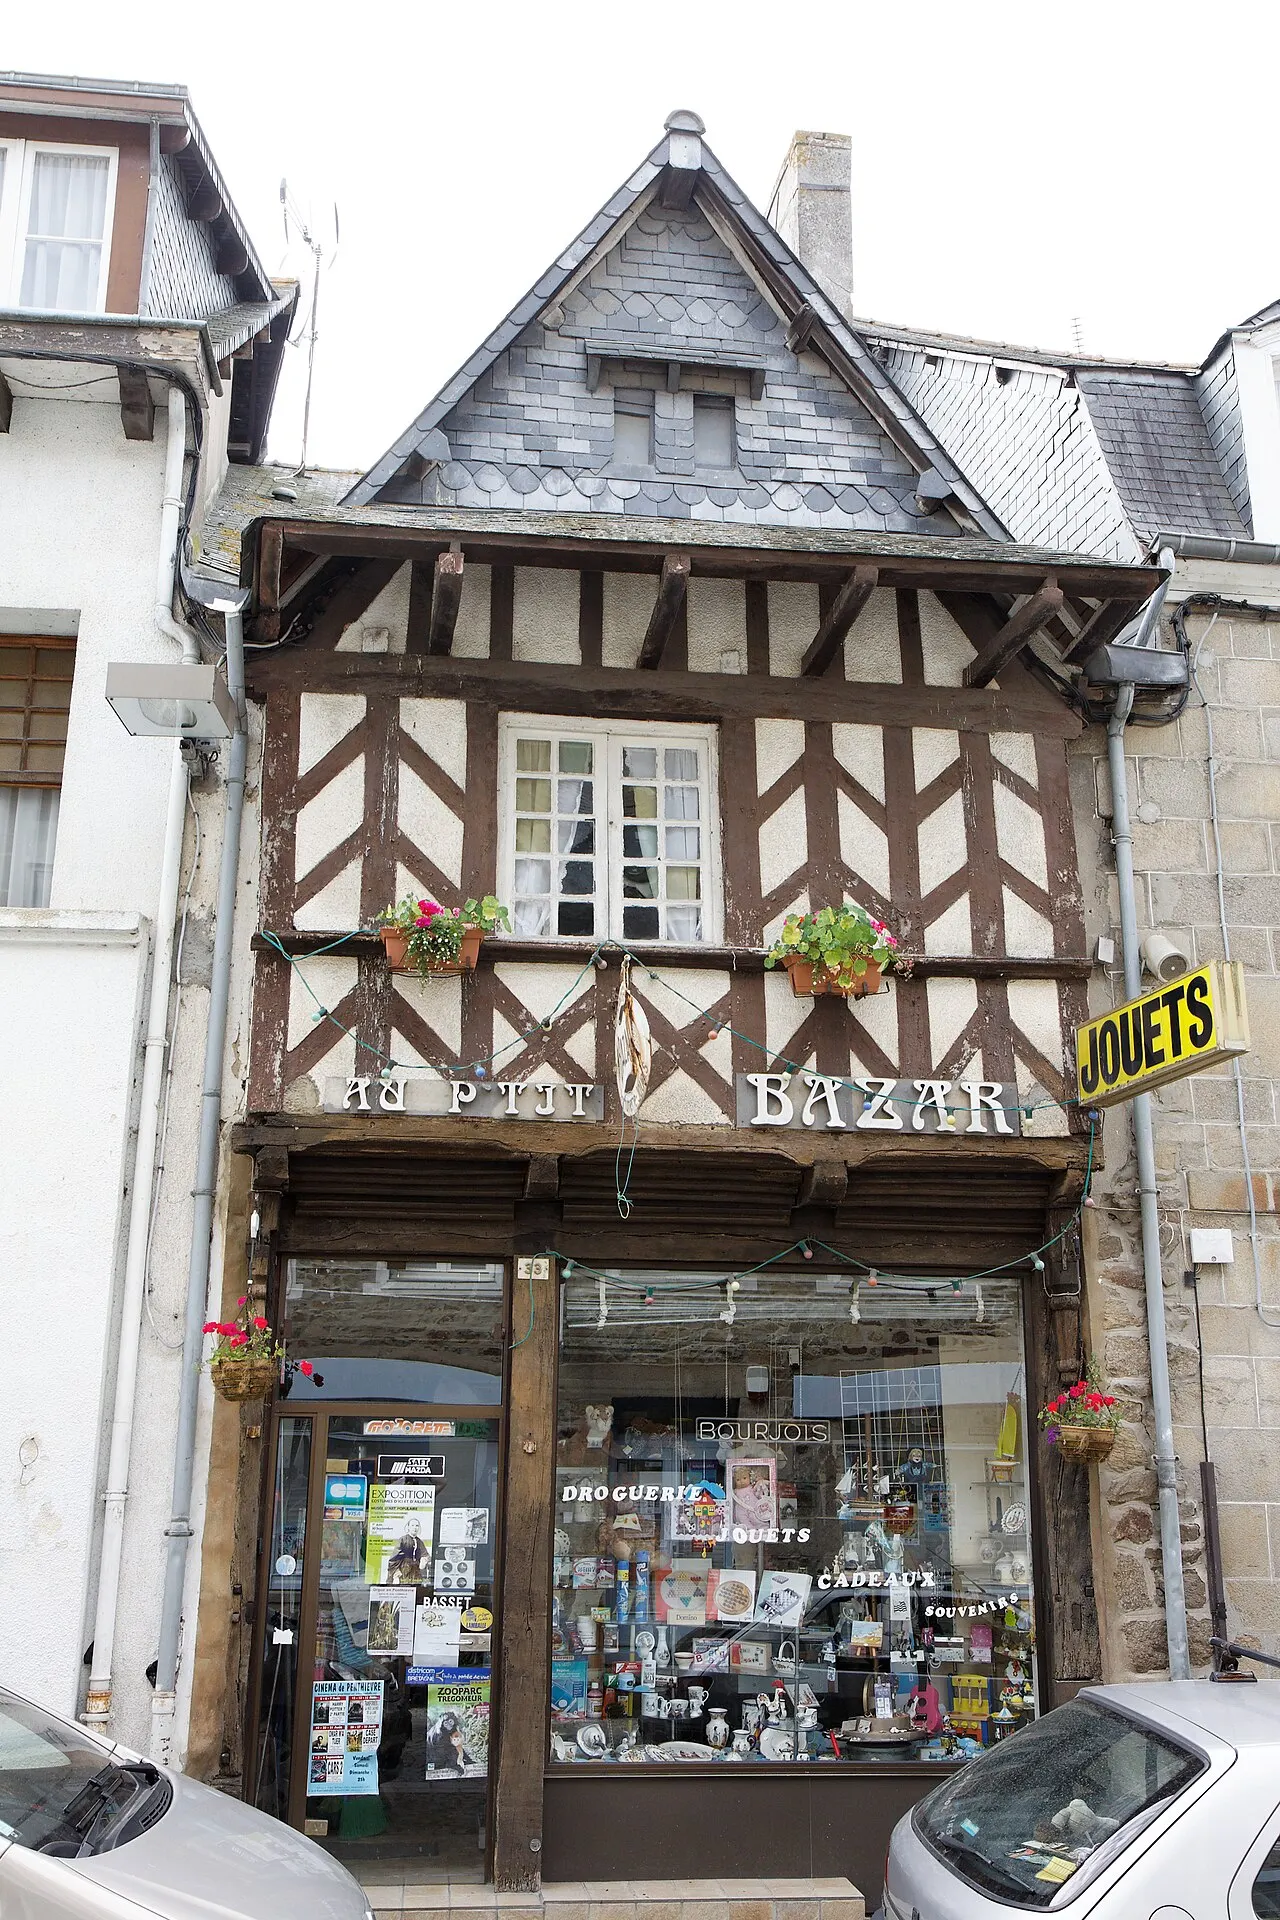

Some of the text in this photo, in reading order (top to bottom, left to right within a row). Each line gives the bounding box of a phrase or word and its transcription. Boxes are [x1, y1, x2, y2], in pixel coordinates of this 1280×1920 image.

[1081, 976, 1213, 1094] JOUETS
[343, 1078, 407, 1111] AU
[746, 1073, 1014, 1134] BAZAR
[700, 1422, 828, 1441] BOURJOIS
[407, 1457, 432, 1466] SAFT
[405, 1466, 432, 1474] MAZDA
[371, 1489, 433, 1499] EXPOSITION
[562, 1485, 704, 1502] DROGUERIE
[716, 1528, 811, 1544] JOUETS
[817, 1572, 936, 1589] CADEAUX
[423, 1596, 472, 1610] BASSET
[925, 1593, 1019, 1618] SOUVENIRS
[314, 1682, 337, 1692] CINEMA
[339, 1682, 345, 1691] de
[437, 1687, 482, 1695] ZOOPARC
